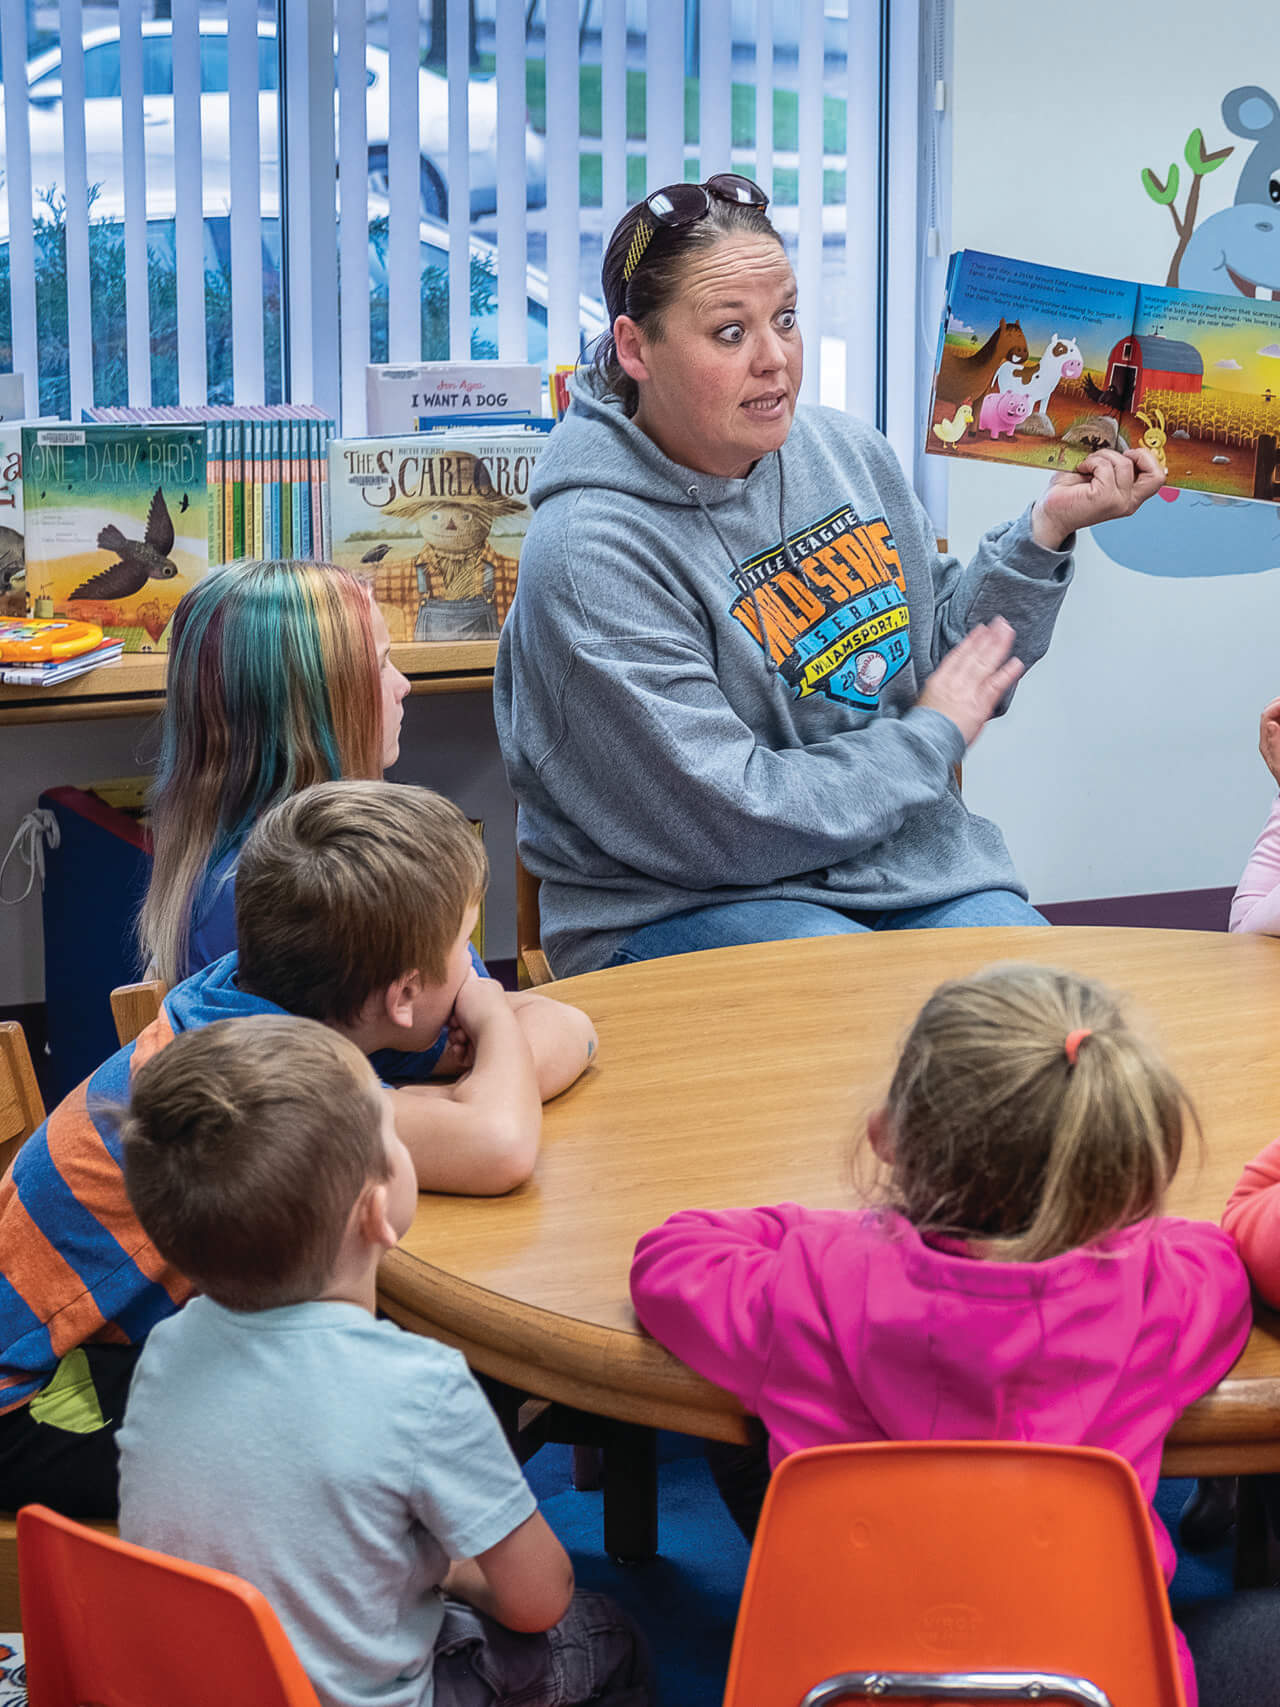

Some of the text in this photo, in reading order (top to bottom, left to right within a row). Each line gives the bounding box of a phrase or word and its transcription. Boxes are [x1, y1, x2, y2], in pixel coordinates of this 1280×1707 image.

[411, 393, 508, 408] I WANT A DOG
[30, 442, 196, 484] ONE DARK BIRD
[344, 448, 535, 507] THE SCARECRO
[786, 511, 858, 563] LEAGUE
